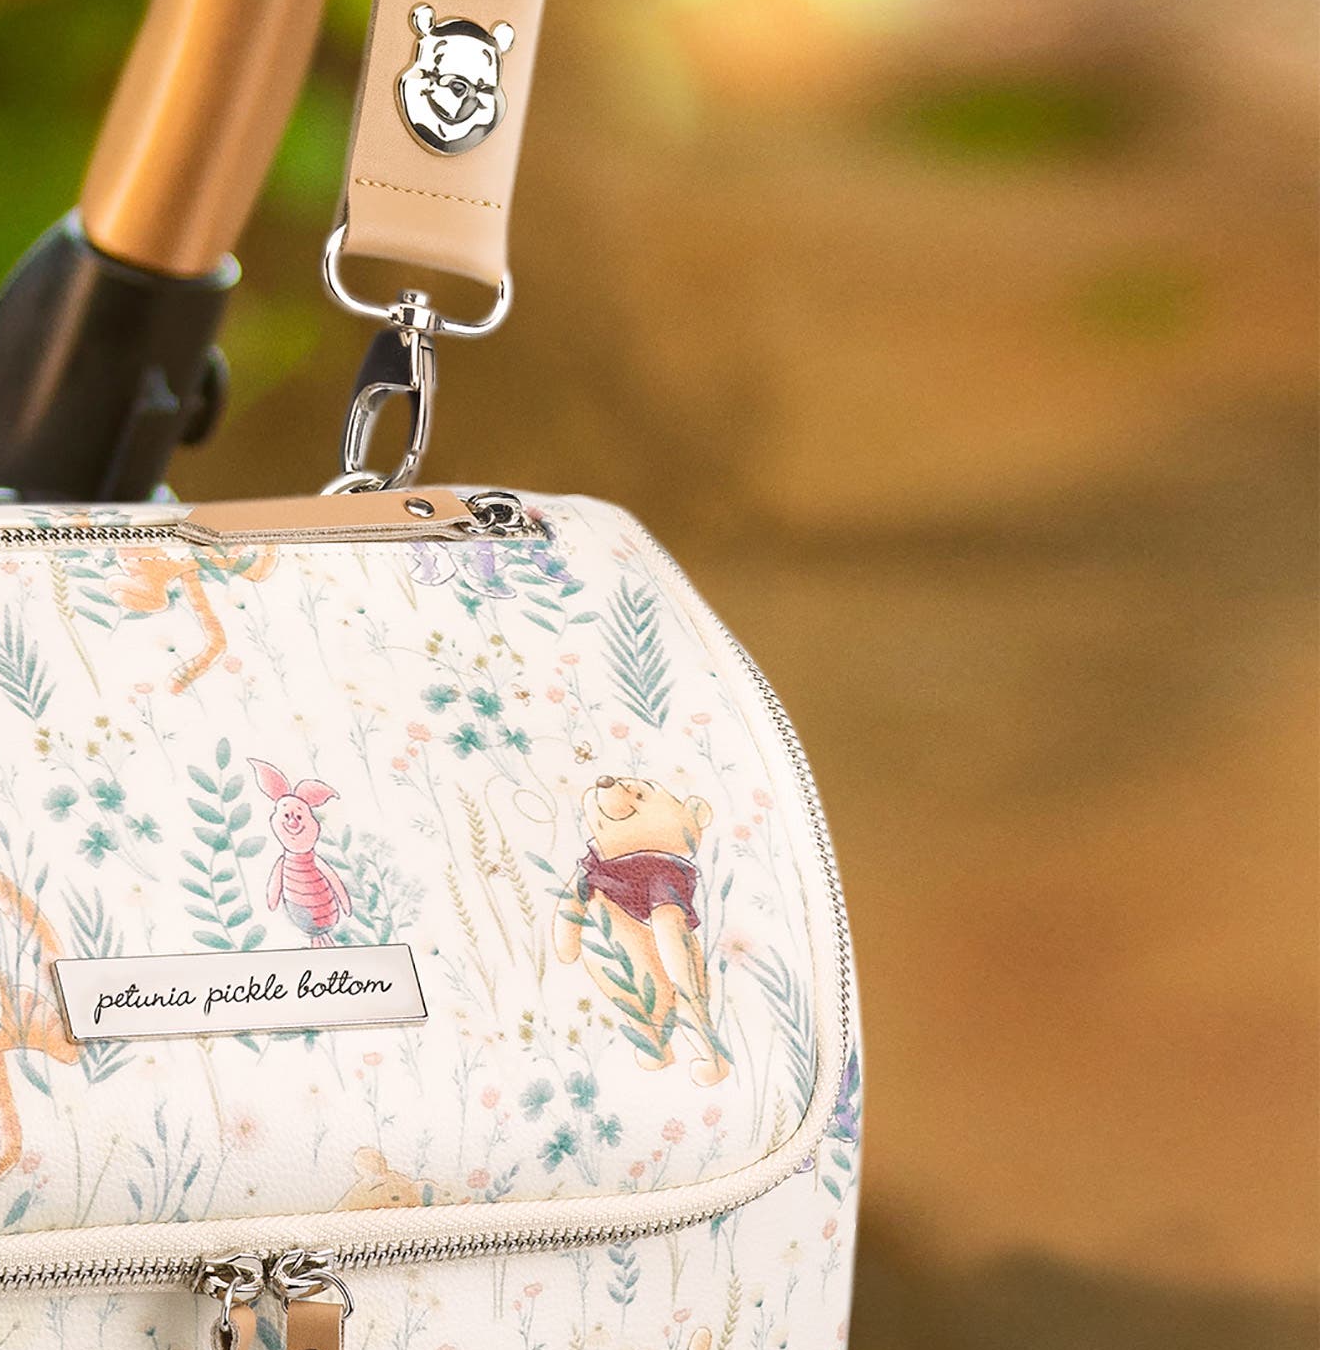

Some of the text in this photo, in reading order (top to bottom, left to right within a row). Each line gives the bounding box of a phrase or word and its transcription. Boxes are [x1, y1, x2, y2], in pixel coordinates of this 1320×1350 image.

[93, 969, 393, 1025] petunia pickle bottom
